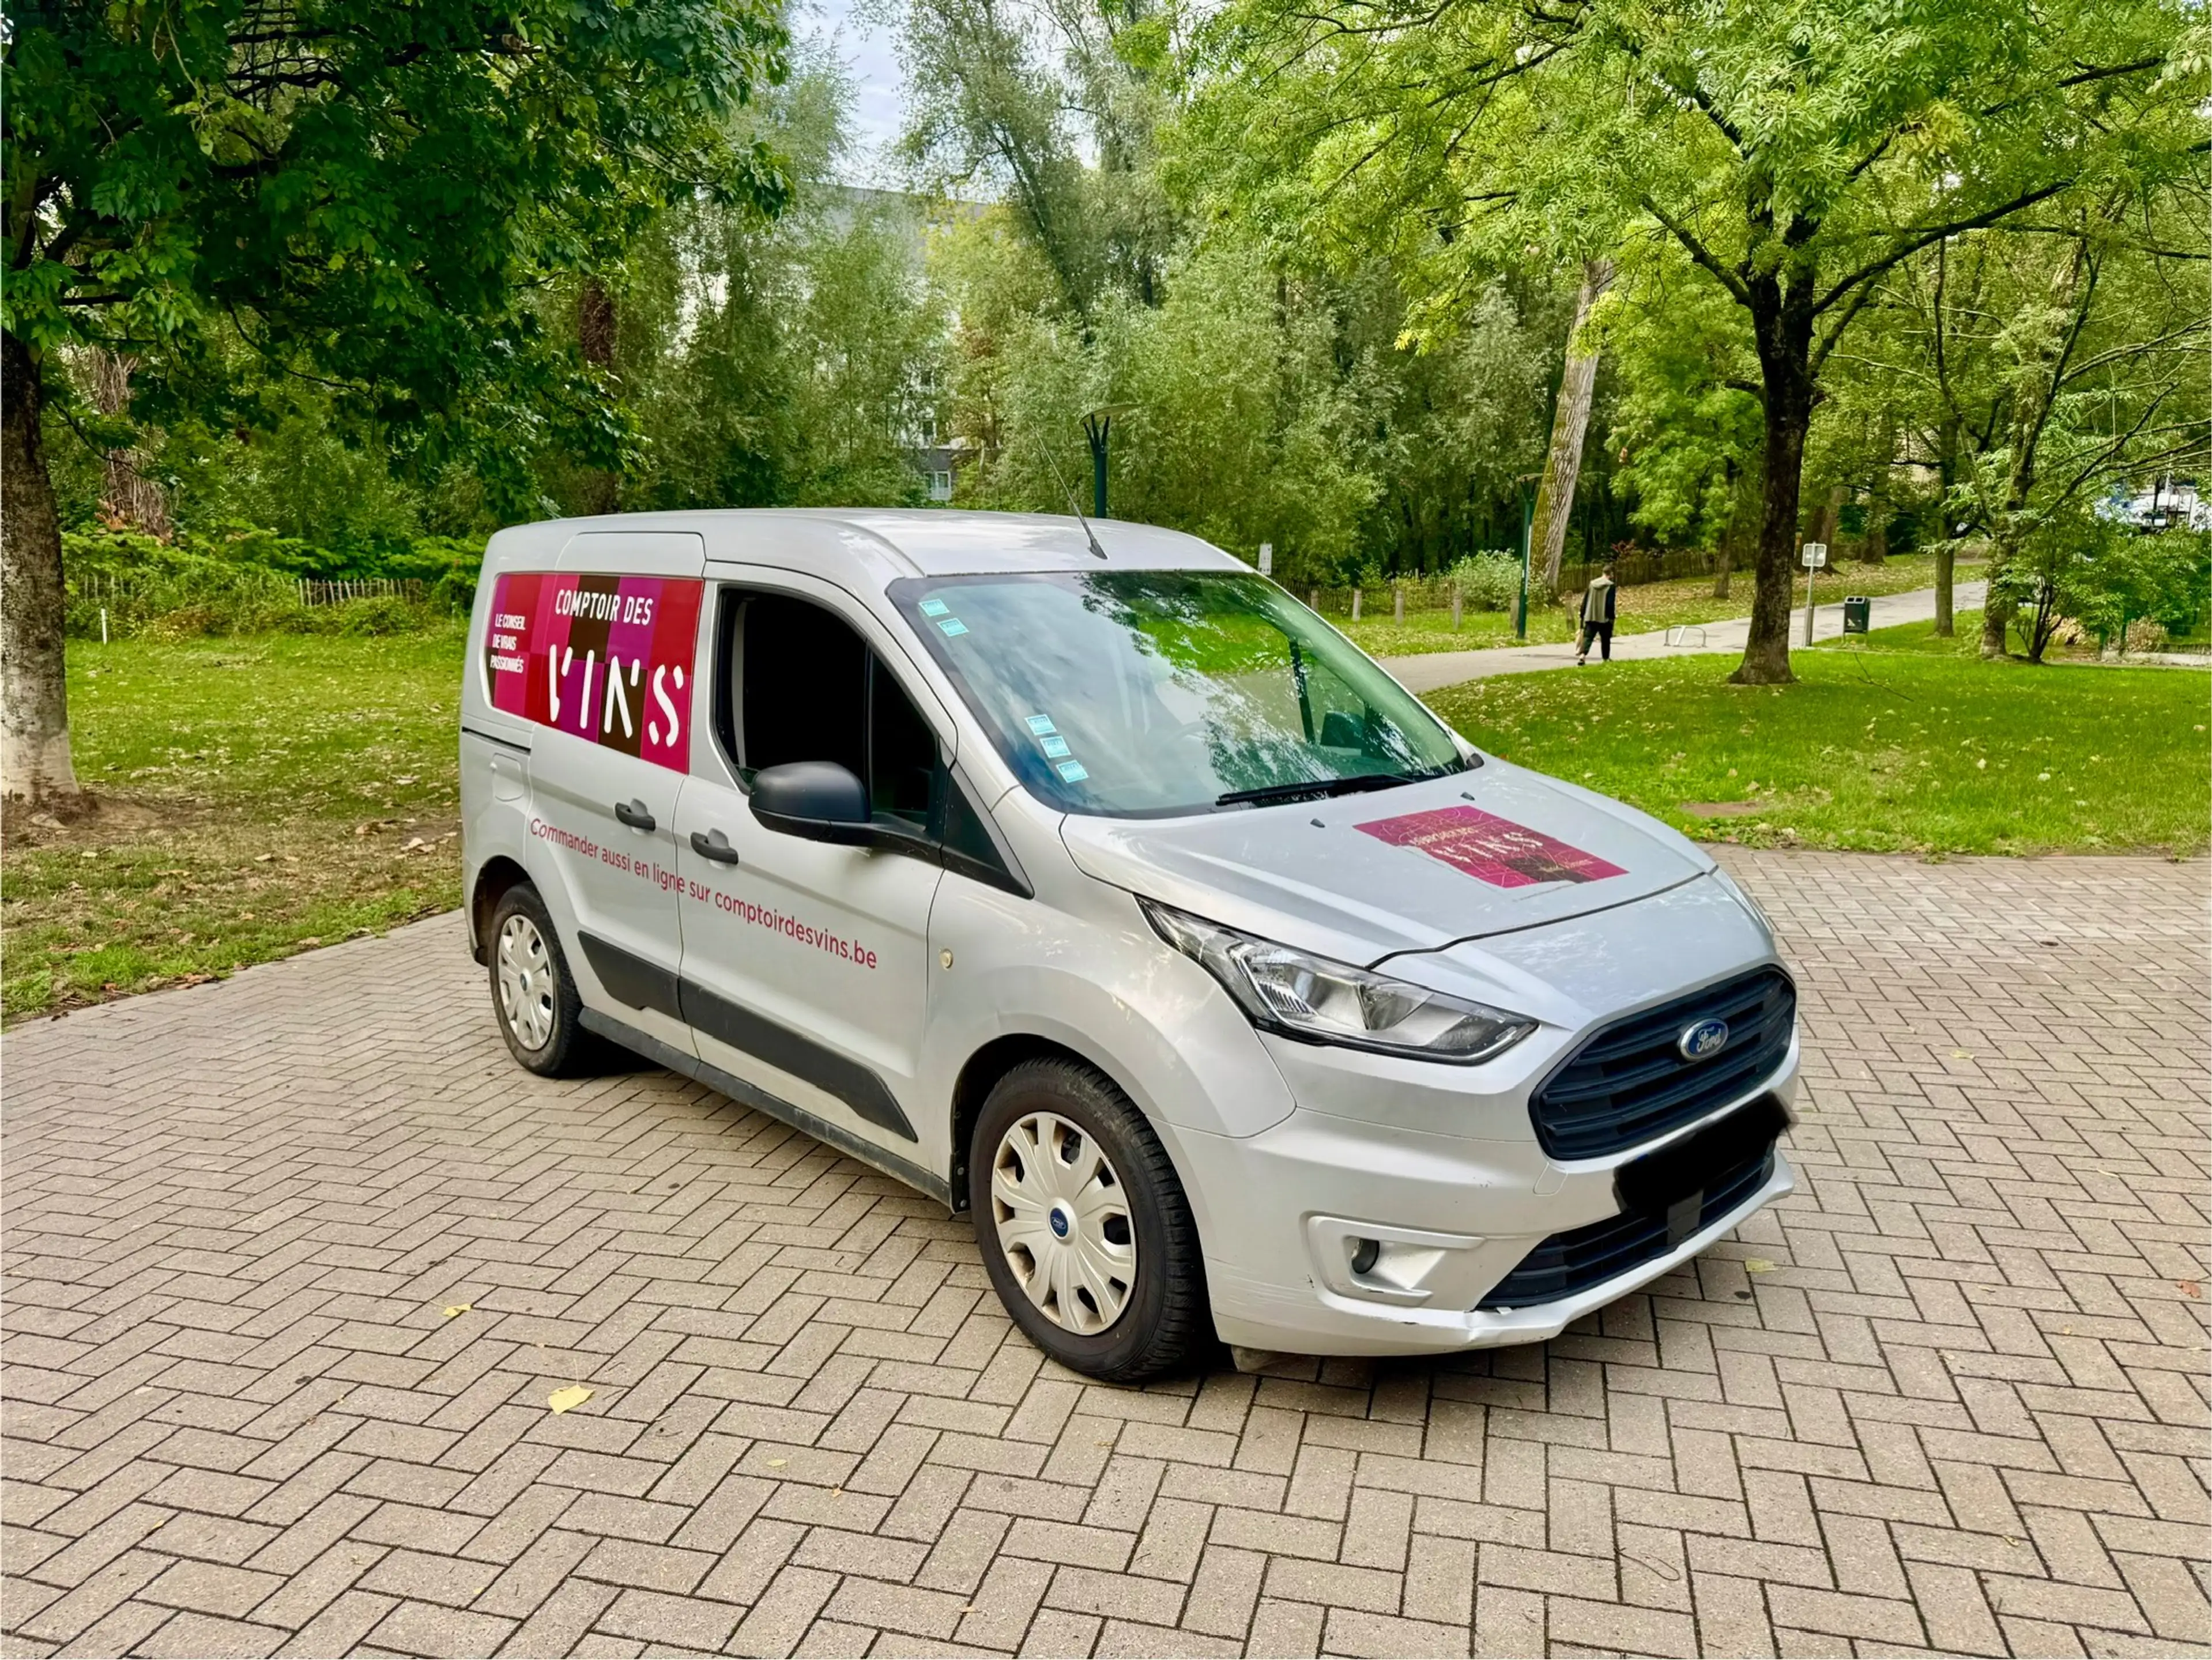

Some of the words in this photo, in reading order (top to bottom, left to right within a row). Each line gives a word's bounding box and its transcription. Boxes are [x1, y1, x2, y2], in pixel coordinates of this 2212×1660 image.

[495, 614, 503, 628] LE
[555, 589, 621, 621] COMPTOIR
[623, 596, 653, 625] DES
[492, 633, 500, 648] DE
[549, 644, 684, 747] VINS
[530, 818, 598, 858] Commander
[601, 847, 630, 872] aussi
[634, 859, 649, 879] en
[653, 862, 685, 893] ligne
[689, 881, 710, 903] sur
[715, 891, 876, 969] comptoirdesvins.be
[1696, 1026, 1721, 1052] Ford
